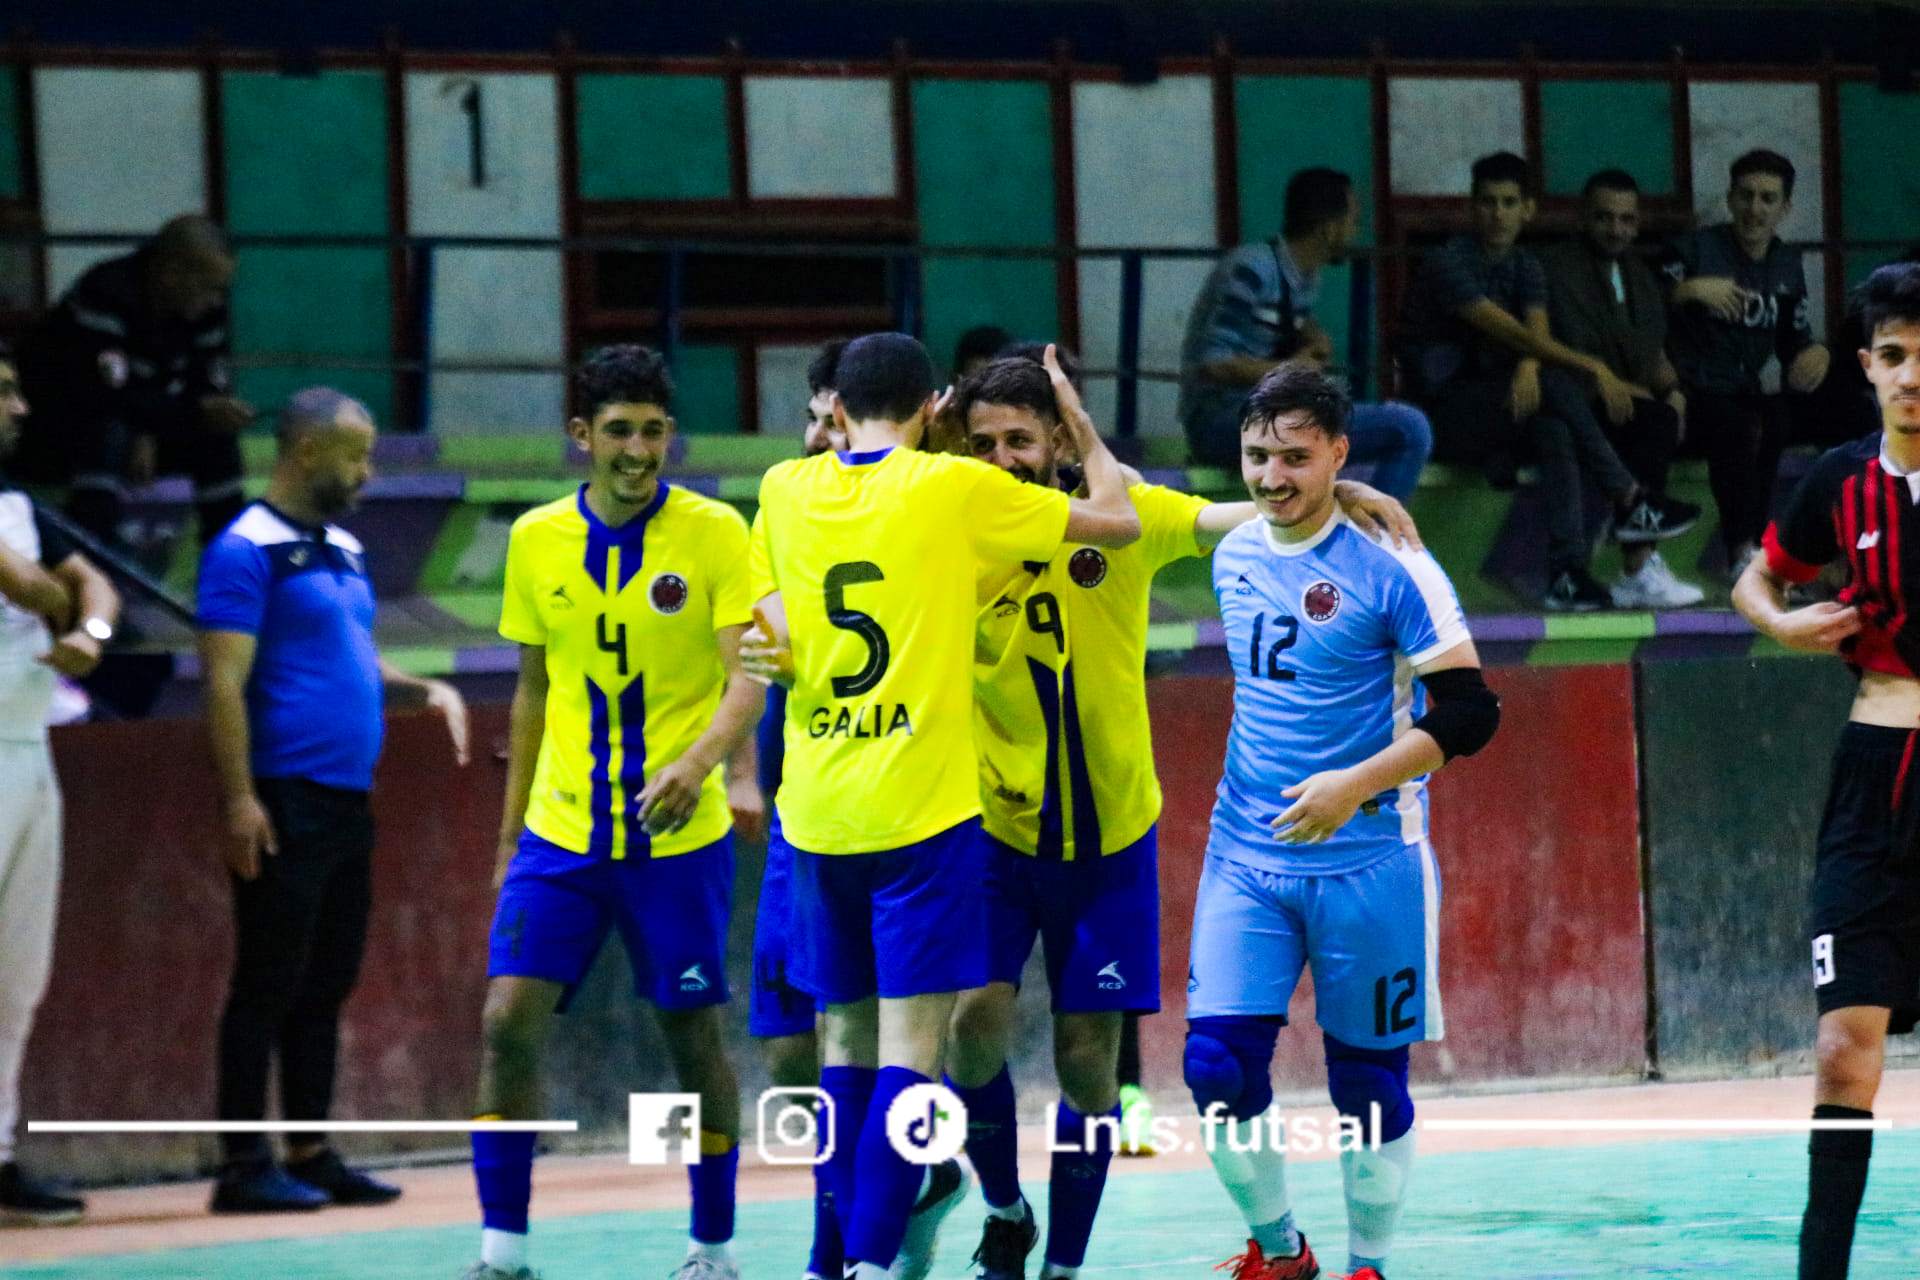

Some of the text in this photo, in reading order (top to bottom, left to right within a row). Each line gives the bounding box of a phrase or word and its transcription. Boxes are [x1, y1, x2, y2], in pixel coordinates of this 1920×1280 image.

[448, 77, 485, 190] 1
[596, 612, 628, 676] 4
[823, 560, 890, 698] 5
[1026, 591, 1064, 654] 9
[1250, 611, 1299, 681] 12
[808, 703, 913, 739] GALIA
[1098, 982, 1122, 990] KCS
[1374, 967, 1417, 1037] 12
